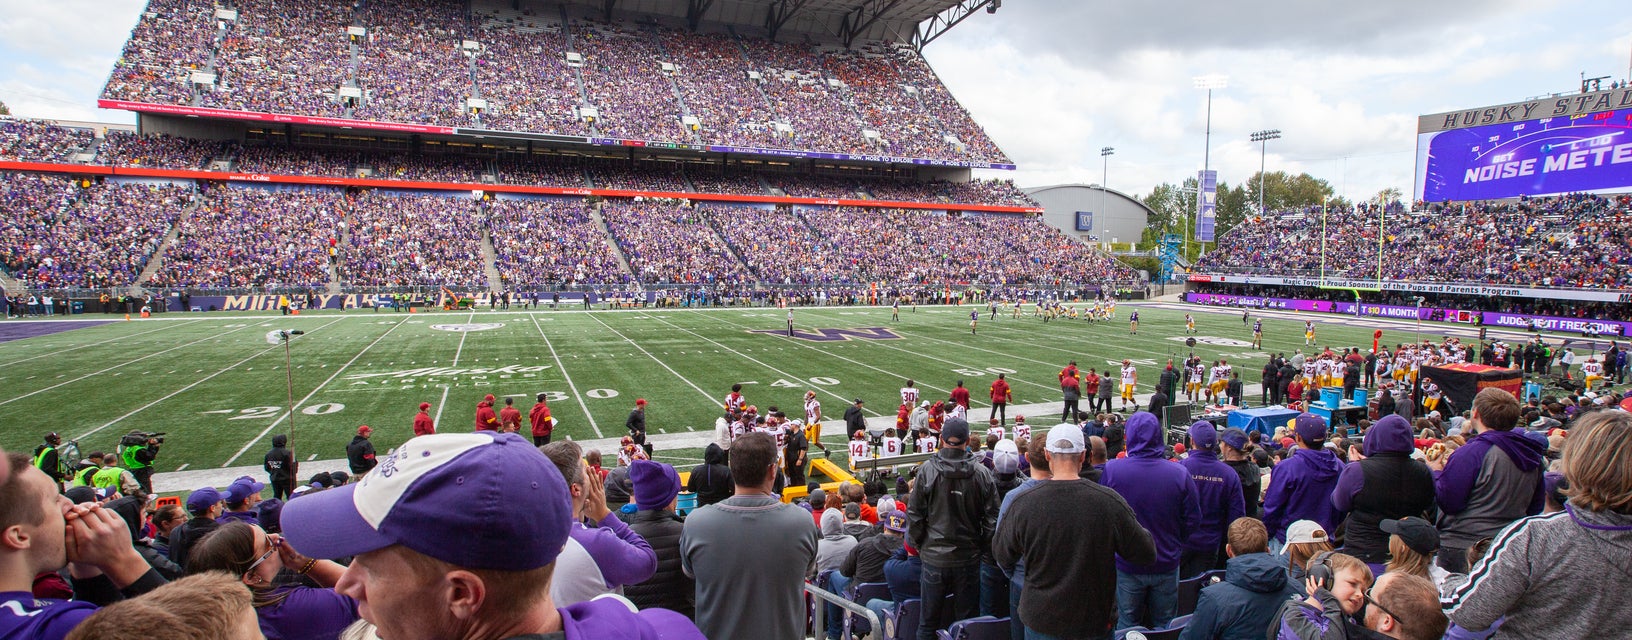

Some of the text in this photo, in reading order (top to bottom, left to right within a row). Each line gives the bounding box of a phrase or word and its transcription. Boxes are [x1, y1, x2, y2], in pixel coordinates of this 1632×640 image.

[1442, 102, 1539, 129] HUSKY
[1463, 158, 1537, 184] NOISE
[1080, 215, 1092, 226] W
[1282, 278, 1300, 286] Magic
[1446, 285, 1479, 293] Parents
[1481, 287, 1523, 296] Program.
[1347, 305, 1366, 314] JUT
[1368, 307, 1380, 315] $10
[1388, 308, 1418, 317] MONTH
[1585, 364, 1597, 373] 40
[770, 377, 840, 388] 40
[903, 391, 915, 402] 30
[852, 444, 863, 457] 14
[887, 440, 896, 453] 6
[927, 441, 934, 453] 8
[1191, 474, 1225, 482] USKIES
